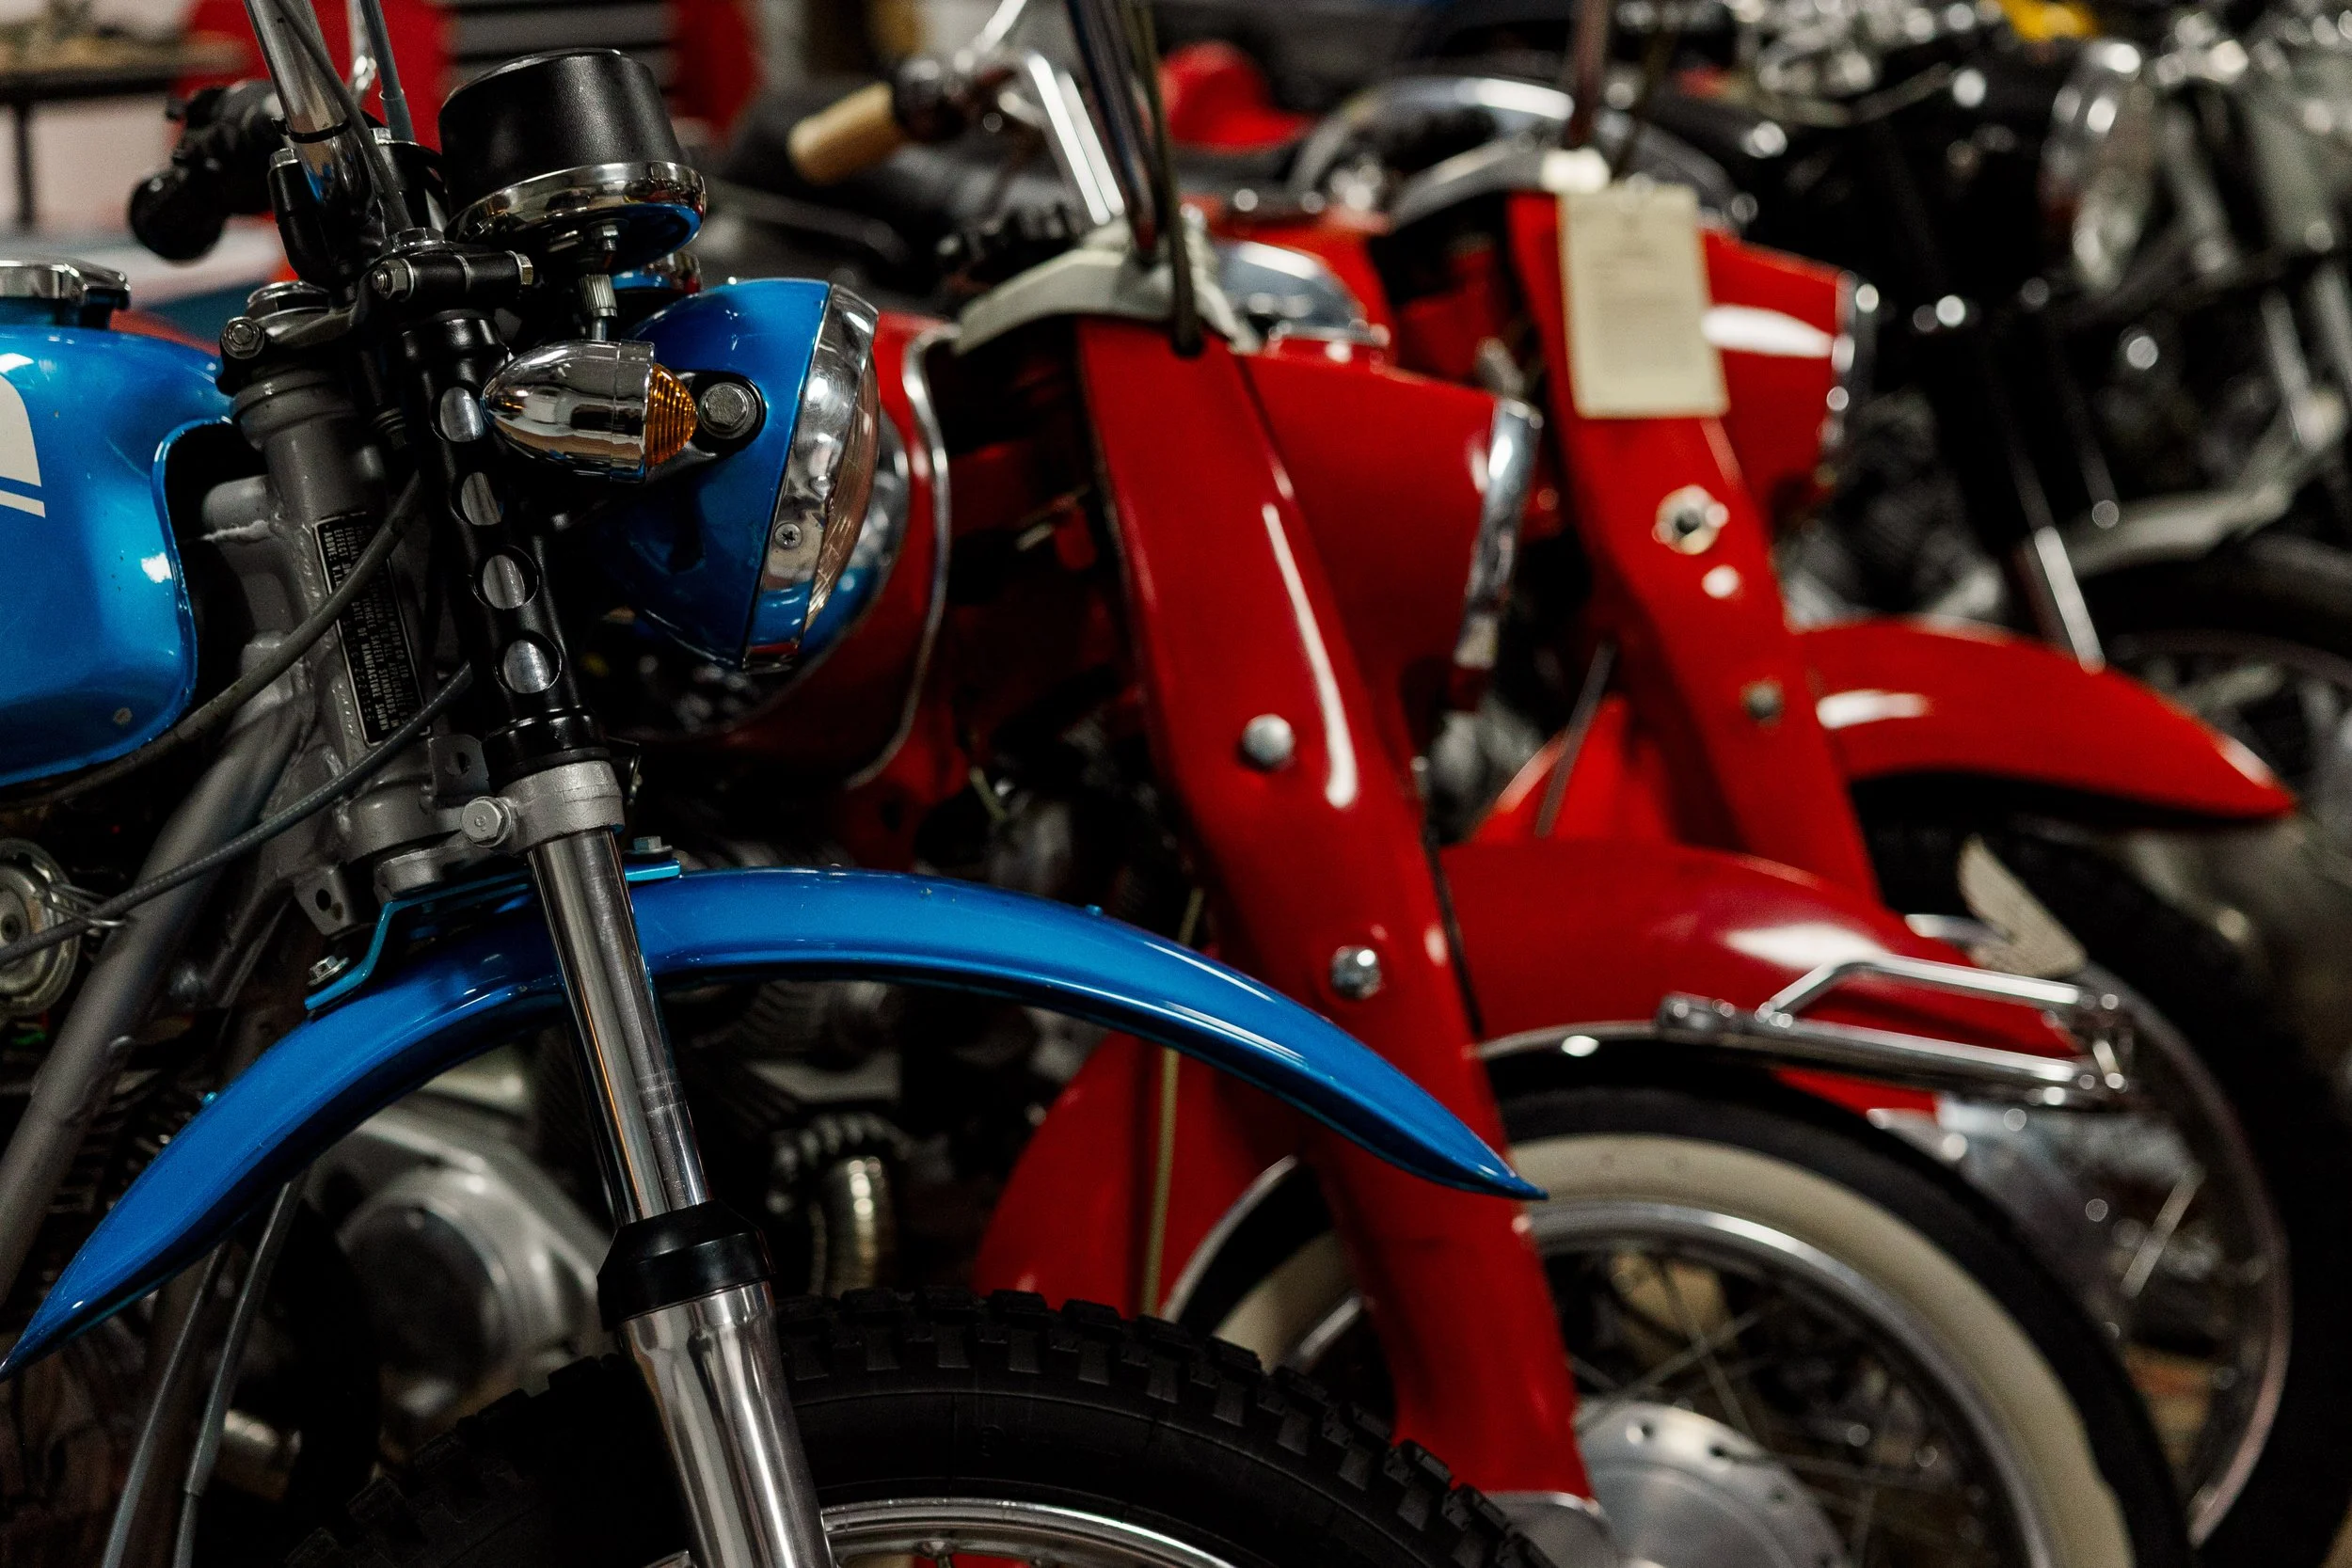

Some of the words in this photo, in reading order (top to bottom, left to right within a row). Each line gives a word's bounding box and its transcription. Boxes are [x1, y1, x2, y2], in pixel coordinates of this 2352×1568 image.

[323, 531, 339, 562] ABOVE:
[333, 528, 348, 557] EFFECT
[350, 600, 363, 622] DATE
[343, 526, 360, 561] FEDERAL
[360, 596, 376, 629] VEHICLE
[369, 634, 385, 663] SAFETY
[377, 667, 397, 715] STANDARDS
[389, 718, 401, 728] IN
[357, 626, 368, 638] OF
[388, 620, 402, 647] MOTOR
[382, 641, 394, 657] ALL
[360, 641, 382, 698] MANUFACTURE
[387, 660, 406, 706] APPLICABLE
[374, 702, 389, 731] SHOWN
